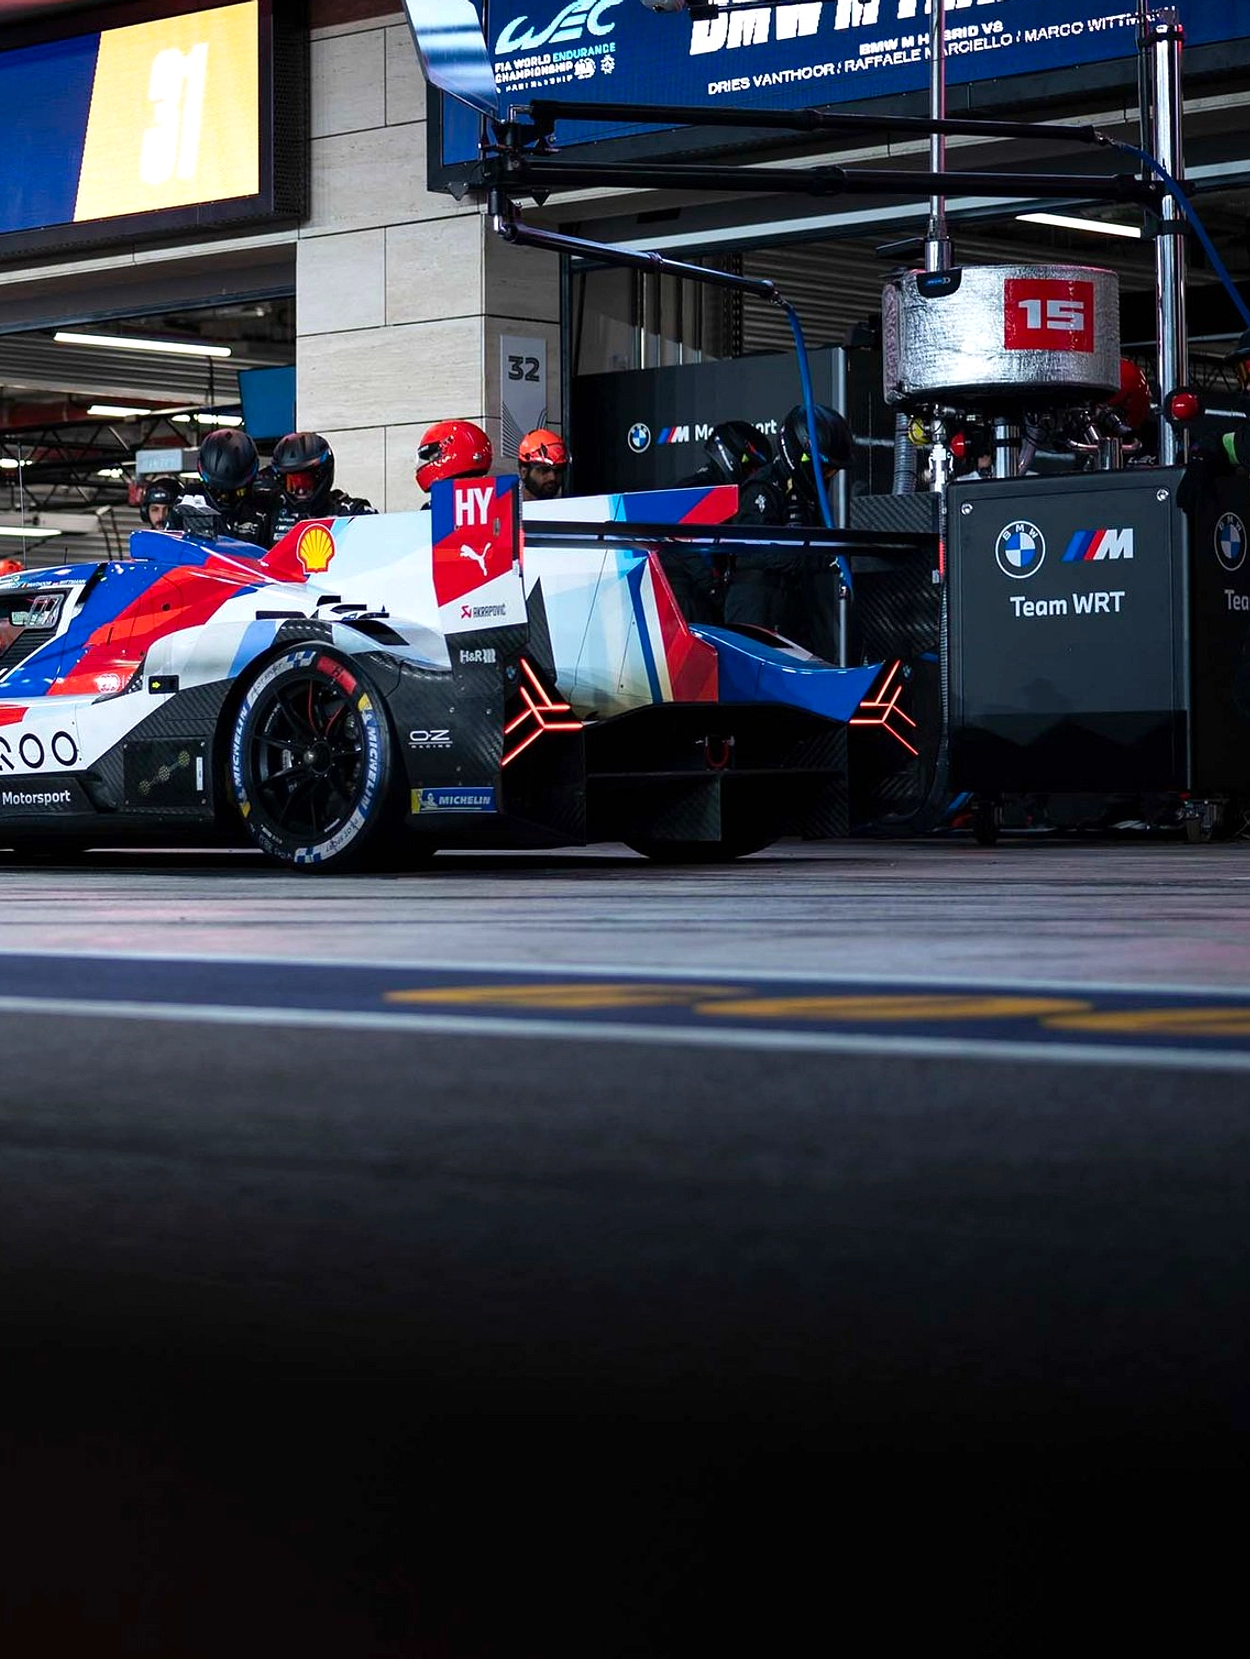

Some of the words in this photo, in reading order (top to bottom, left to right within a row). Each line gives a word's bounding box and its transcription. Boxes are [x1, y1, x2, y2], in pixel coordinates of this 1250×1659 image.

[901, 35, 915, 48] M
[918, 24, 978, 44] HBRID
[552, 42, 616, 62] ENDURANCE
[707, 77, 750, 95] DRIES
[752, 64, 834, 88] VANTHOOR
[844, 47, 921, 72] RAFFAELE
[1025, 22, 1085, 42] MARCO
[140, 42, 209, 184] 31
[1018, 299, 1085, 331] 15
[508, 355, 540, 382] 32
[455, 487, 494, 526] HY
[1010, 596, 1068, 617] Team
[1072, 591, 1125, 614] WRT
[460, 650, 483, 664] H&R
[230, 706, 249, 788] MICHELIN
[364, 724, 378, 809] MICHELIN
[2, 790, 71, 806] Motorsport
[438, 796, 491, 805] MICHELIN
